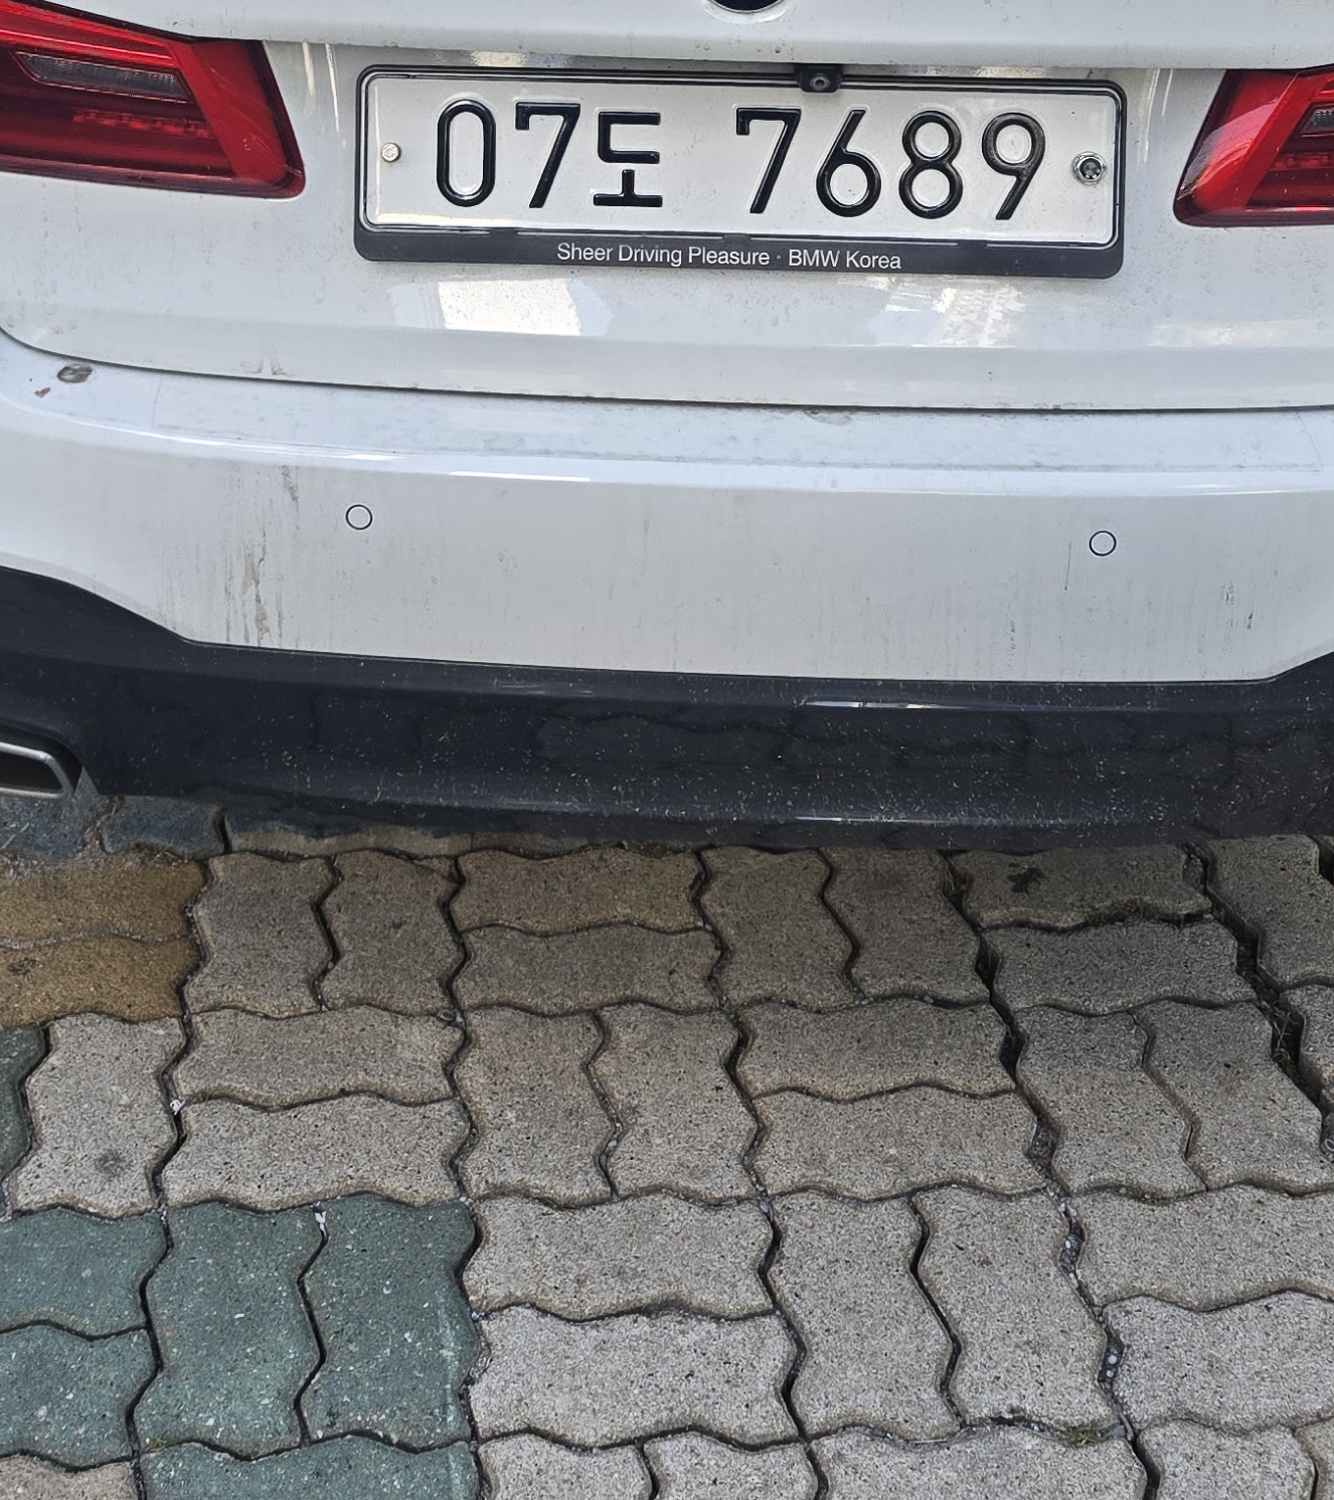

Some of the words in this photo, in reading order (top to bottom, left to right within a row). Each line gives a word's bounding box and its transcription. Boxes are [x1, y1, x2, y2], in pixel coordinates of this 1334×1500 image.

[434, 97, 665, 211] 07도
[734, 106, 1049, 221] 7689
[557, 243, 613, 262] Sheer
[617, 244, 683, 268] Driving
[688, 246, 771, 267] Pleasure
[788, 249, 840, 269] BMW
[845, 250, 902, 270] Korea
